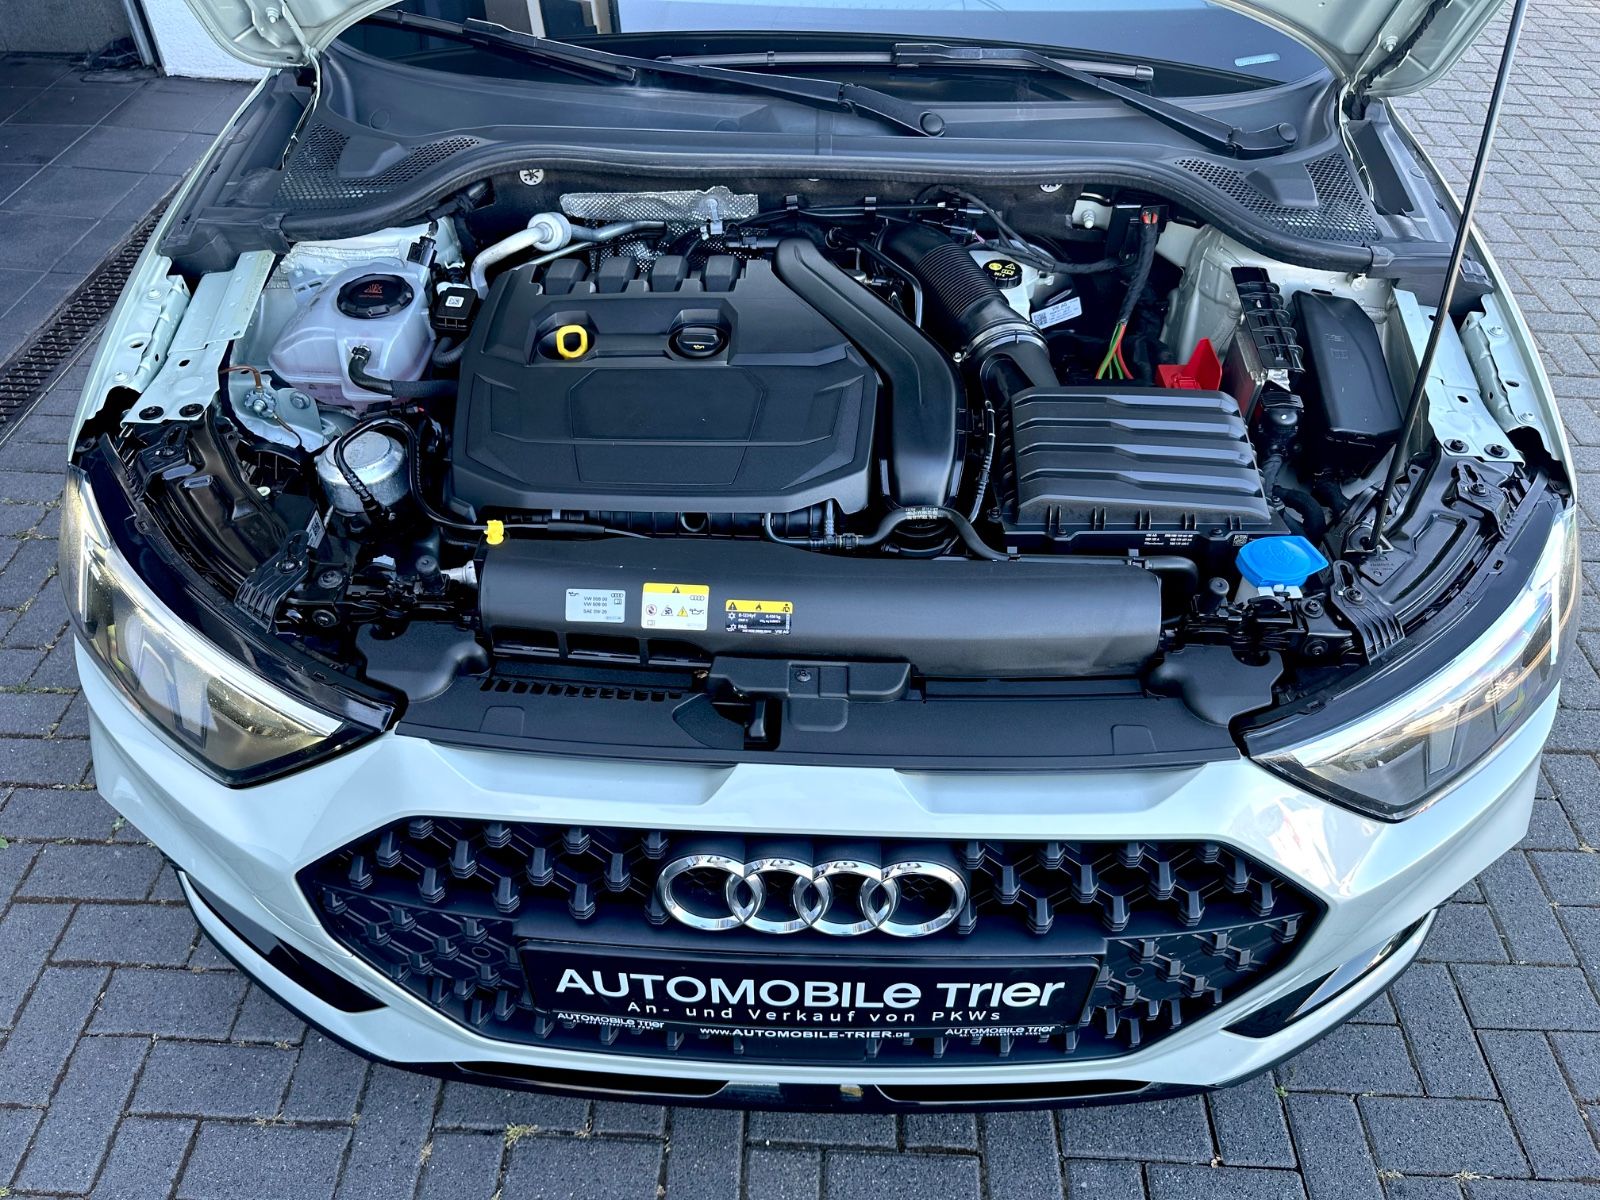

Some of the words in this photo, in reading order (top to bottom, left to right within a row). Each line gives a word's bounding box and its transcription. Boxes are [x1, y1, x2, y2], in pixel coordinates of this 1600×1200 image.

[627, 1001, 670, 1014] An-
[685, 1007, 733, 1019] und
[748, 1009, 856, 1022] Verkauf
[869, 1012, 915, 1022] von
[931, 1010, 1000, 1022] PKWs
